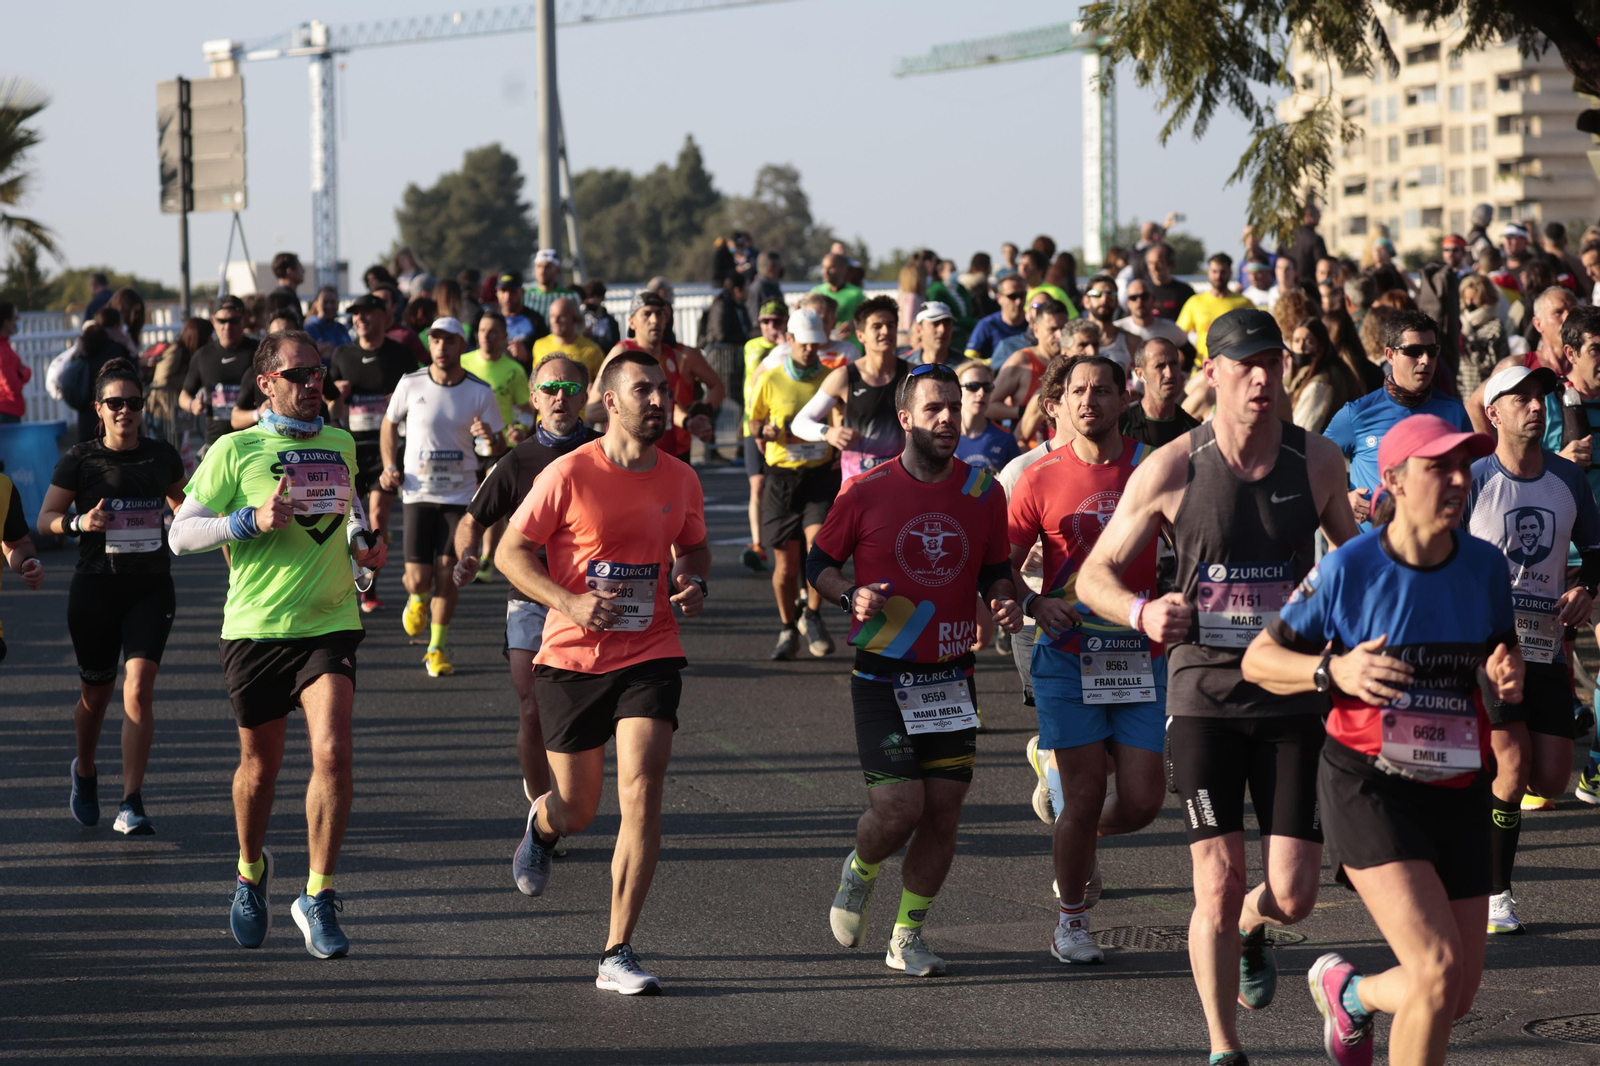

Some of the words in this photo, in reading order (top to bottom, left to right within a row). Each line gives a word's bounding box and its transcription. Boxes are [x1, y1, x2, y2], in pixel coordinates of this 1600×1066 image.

[301, 453, 337, 461] ZURICH
[307, 472, 329, 482] 6677
[306, 488, 336, 497] DAVCAN
[125, 500, 157, 508] ZURICH
[612, 567, 652, 577] ZURICH
[1230, 567, 1283, 579] ZURICH
[1531, 571, 1550, 583] VAZ
[1231, 594, 1261, 607] 7151
[1518, 598, 1554, 611] ZURICH
[1231, 616, 1263, 626] MARC
[1517, 618, 1539, 631] 8519
[939, 620, 976, 641] RUN
[1105, 640, 1141, 648] ZURICH
[1524, 636, 1553, 648] MARTINS
[1106, 660, 1128, 671] 9563
[916, 669, 957, 683] ZURICH
[1094, 678, 1116, 687] FRAN
[1117, 677, 1142, 686] CALLE
[921, 691, 947, 704] 9559
[1414, 694, 1467, 711] ZURICH
[912, 709, 937, 719] MANU
[938, 705, 964, 718] MENA
[1413, 725, 1446, 741] 6628
[1413, 749, 1447, 763] EMILIE
[1186, 798, 1199, 829] FUSION
